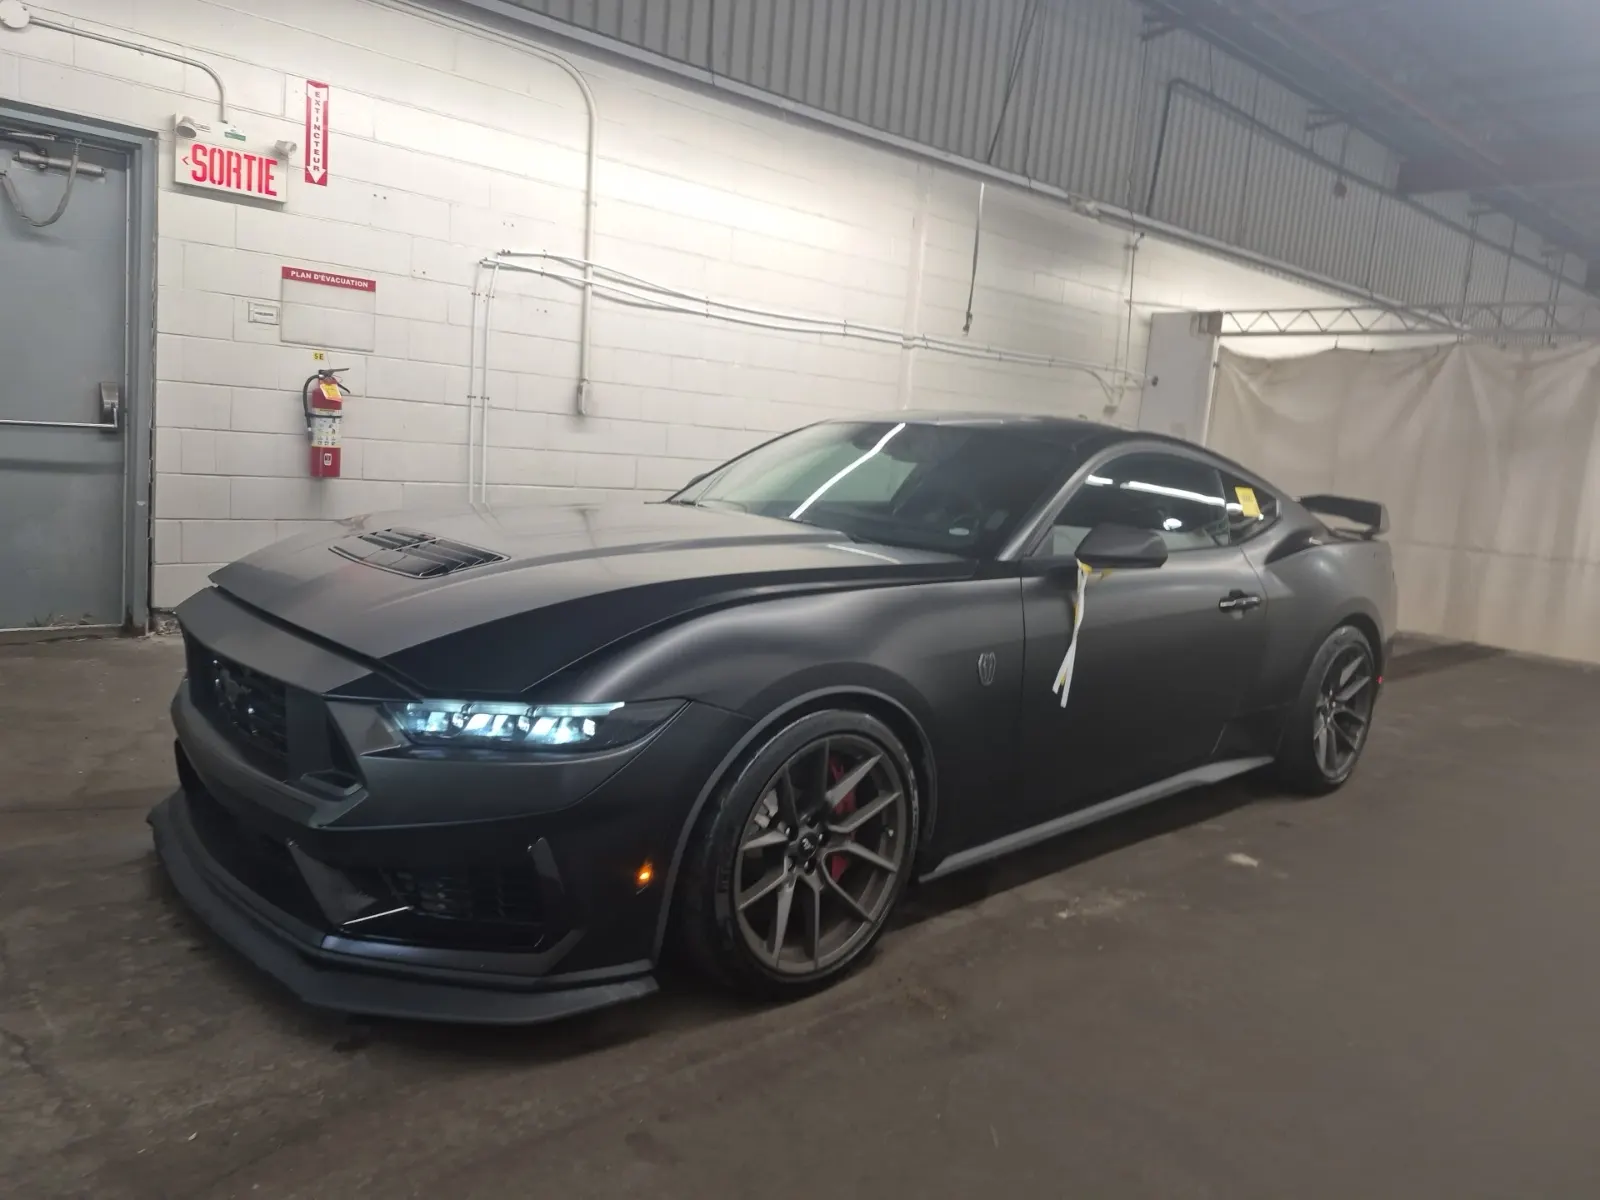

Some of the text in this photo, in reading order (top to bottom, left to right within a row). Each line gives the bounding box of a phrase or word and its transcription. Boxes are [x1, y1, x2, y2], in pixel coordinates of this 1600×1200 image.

[312, 91, 321, 172] EXTINCTEUR
[191, 143, 278, 196] SORTIE
[290, 270, 312, 280] PLAN
